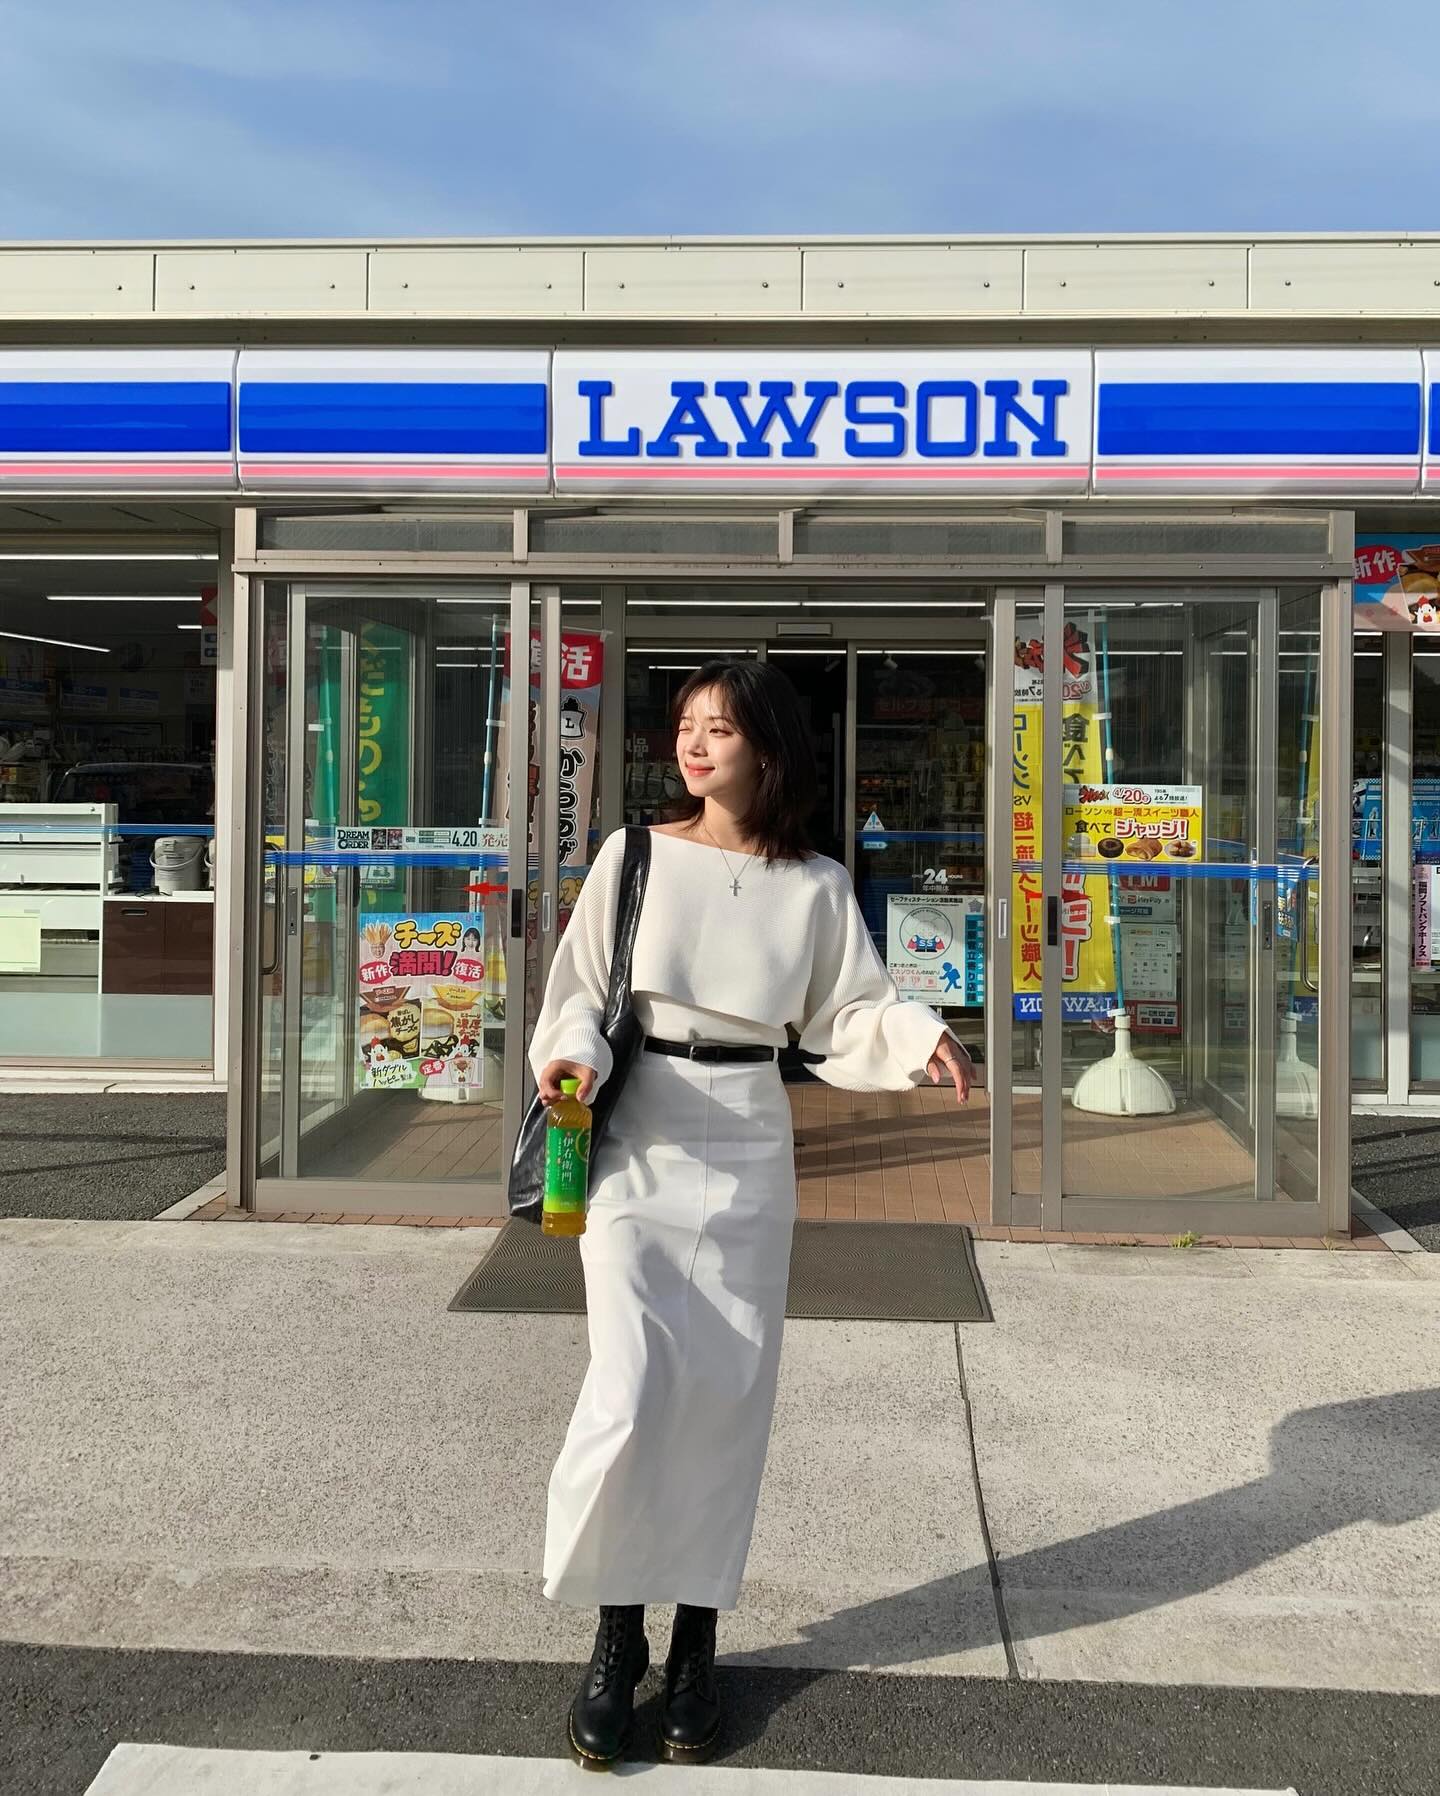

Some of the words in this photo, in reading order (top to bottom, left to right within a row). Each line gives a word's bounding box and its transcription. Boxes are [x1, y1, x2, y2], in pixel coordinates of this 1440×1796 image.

[578, 380, 1068, 457] LAWSON
[1354, 550, 1396, 579] 新作
[565, 718, 575, 728] L
[337, 829, 370, 840] DREAM
[1075, 820, 1112, 834] 食べて
[1116, 820, 1189, 839] ジャッジ!
[338, 840, 370, 849] ORDER
[452, 830, 478, 847] 4.20
[482, 833, 509, 848] 発売
[923, 868, 948, 885] 24
[394, 920, 462, 949] チーズ
[389, 950, 458, 976] 満開!
[455, 961, 481, 979] 復活
[361, 964, 389, 981] 新作
[390, 1012, 419, 1028] 焦がし
[561, 1136, 574, 1182] 伊右衛門
